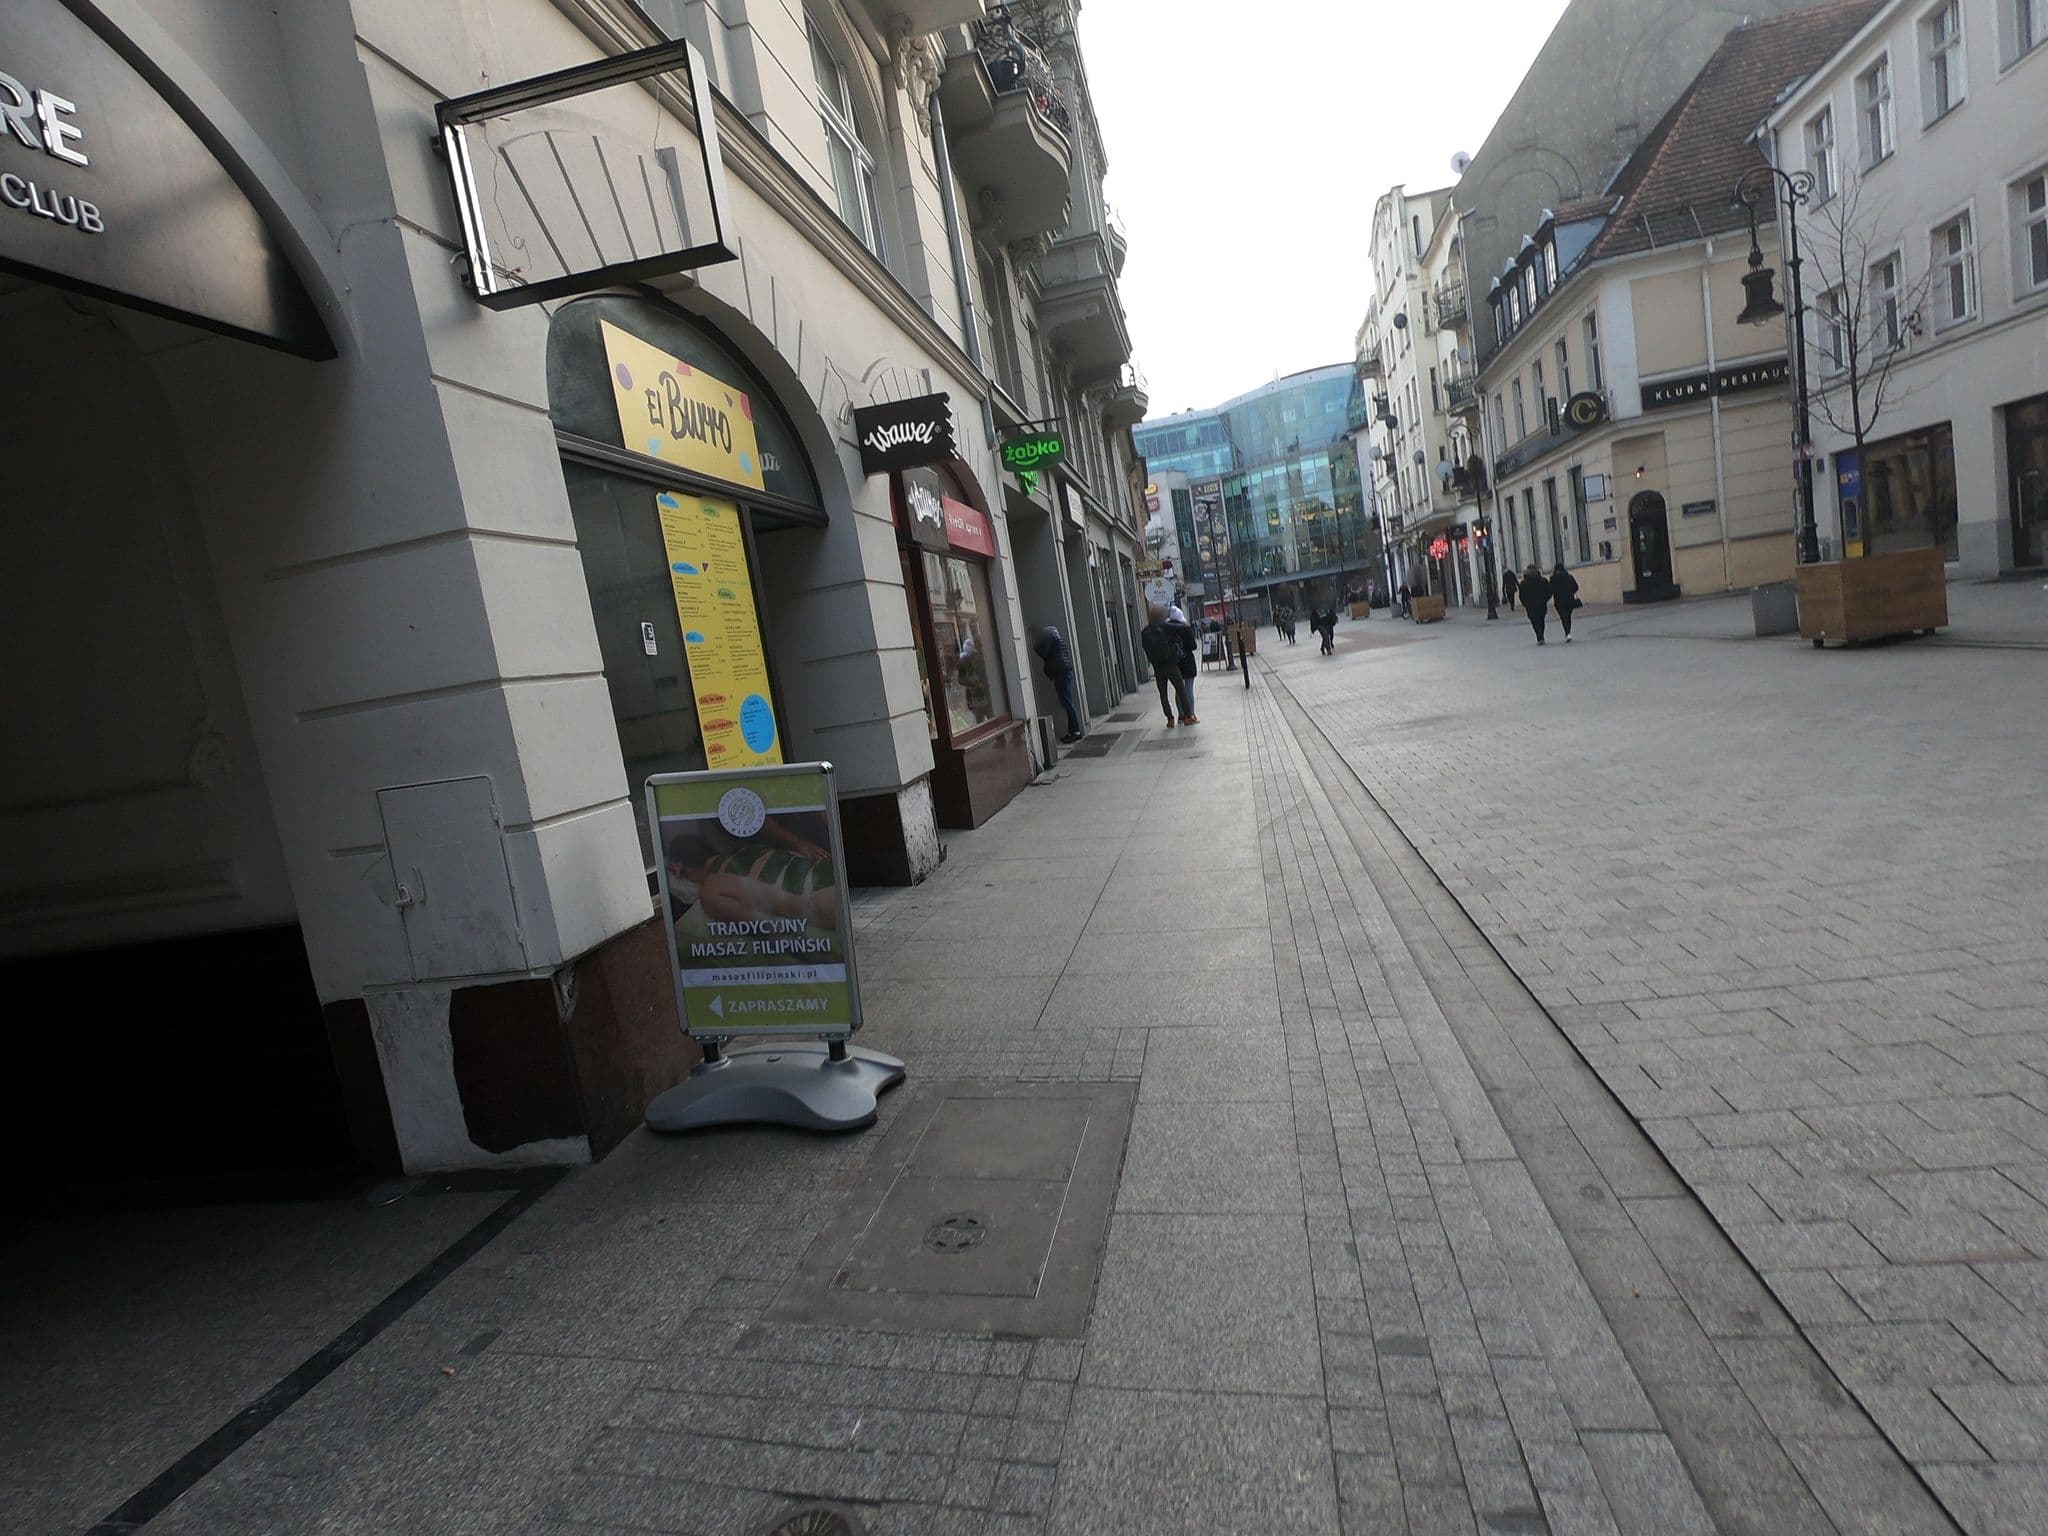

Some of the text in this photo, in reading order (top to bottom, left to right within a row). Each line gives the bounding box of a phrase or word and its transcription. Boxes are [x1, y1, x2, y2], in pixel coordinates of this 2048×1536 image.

[0, 172, 105, 233] CLUB
[1655, 384, 1694, 401] KLUB
[863, 420, 937, 453] Wawel
[1006, 439, 1061, 462] żabka
[707, 917, 808, 936] TRADYCYJNY
[690, 935, 832, 958] MASAŻ FILIPIŃSKI
[711, 969, 818, 983] masazfilipinski.pl
[727, 998, 830, 1014] ZAPRASZAMY
